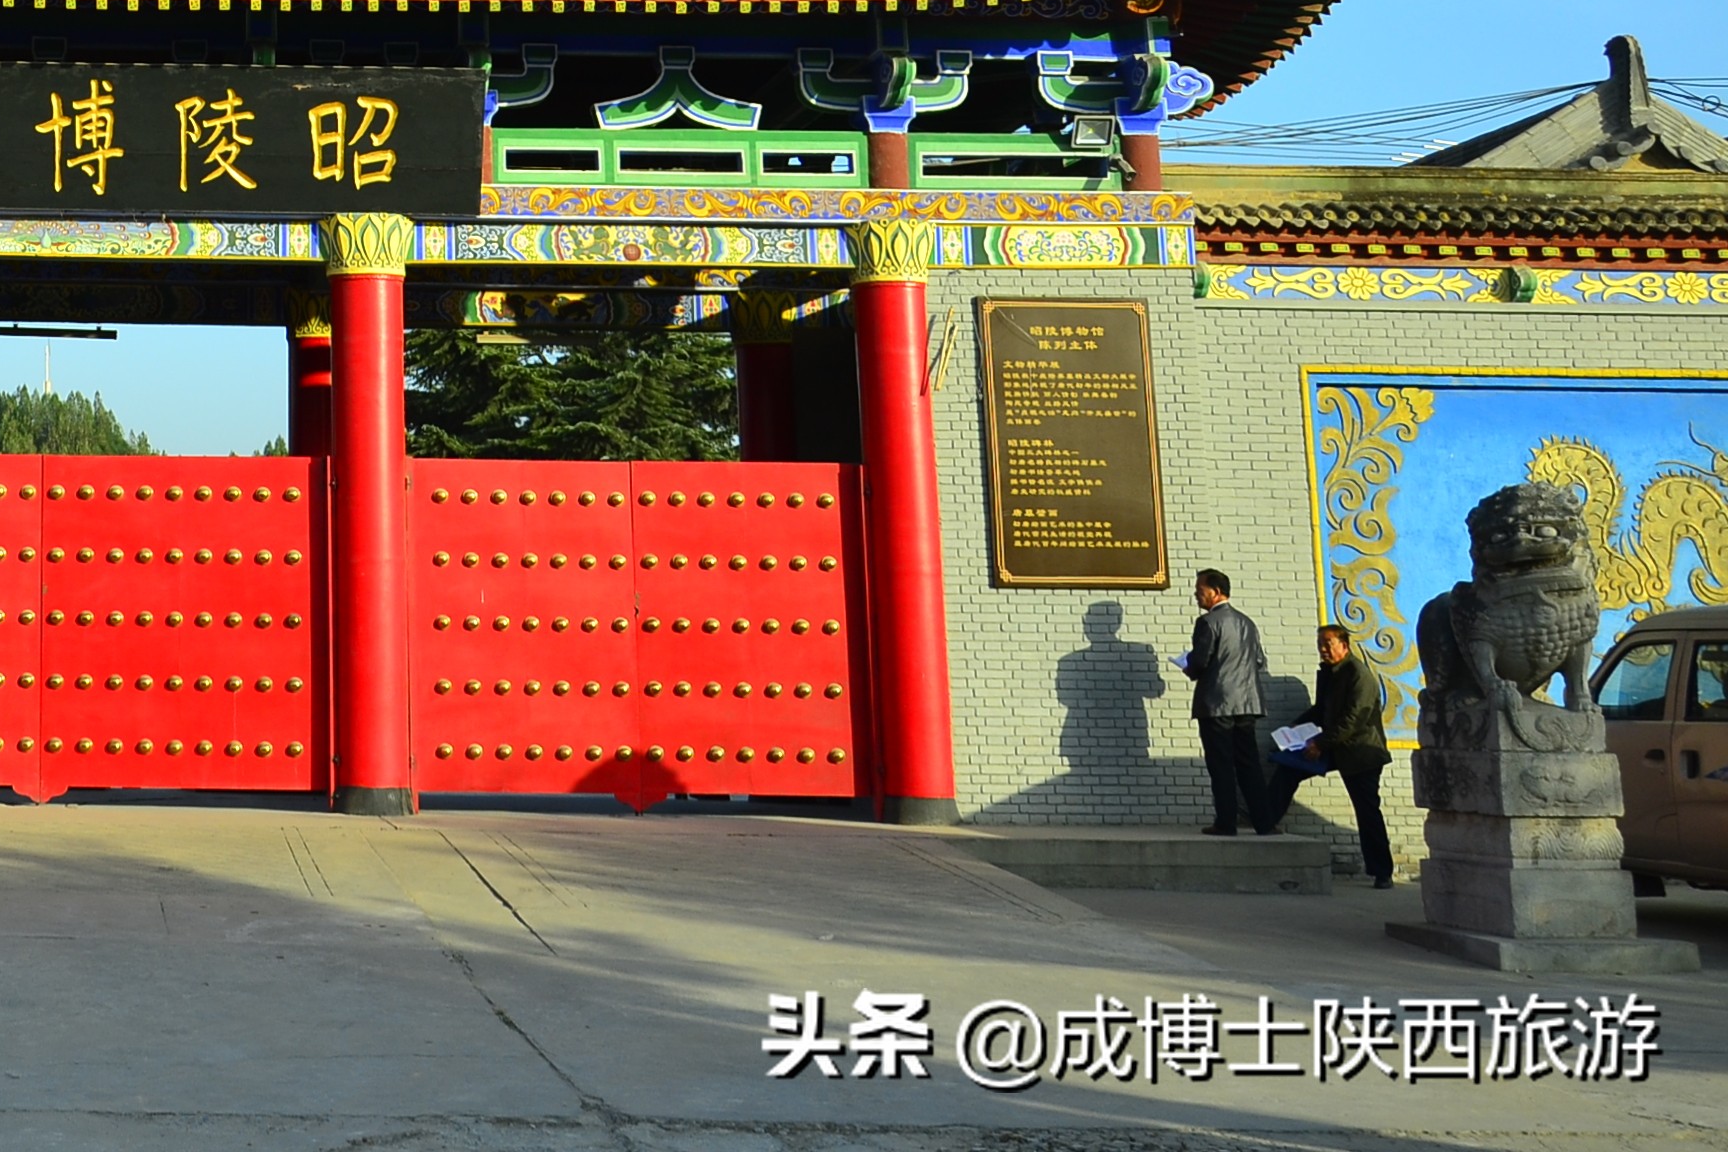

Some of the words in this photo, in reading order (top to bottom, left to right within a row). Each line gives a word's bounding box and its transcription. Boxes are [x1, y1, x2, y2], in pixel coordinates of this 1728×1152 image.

[1029, 325, 1105, 338] 昭陵博物馆
[1038, 339, 1098, 351] 陈列主体
[1007, 438, 1055, 448] 昭陵碑林
